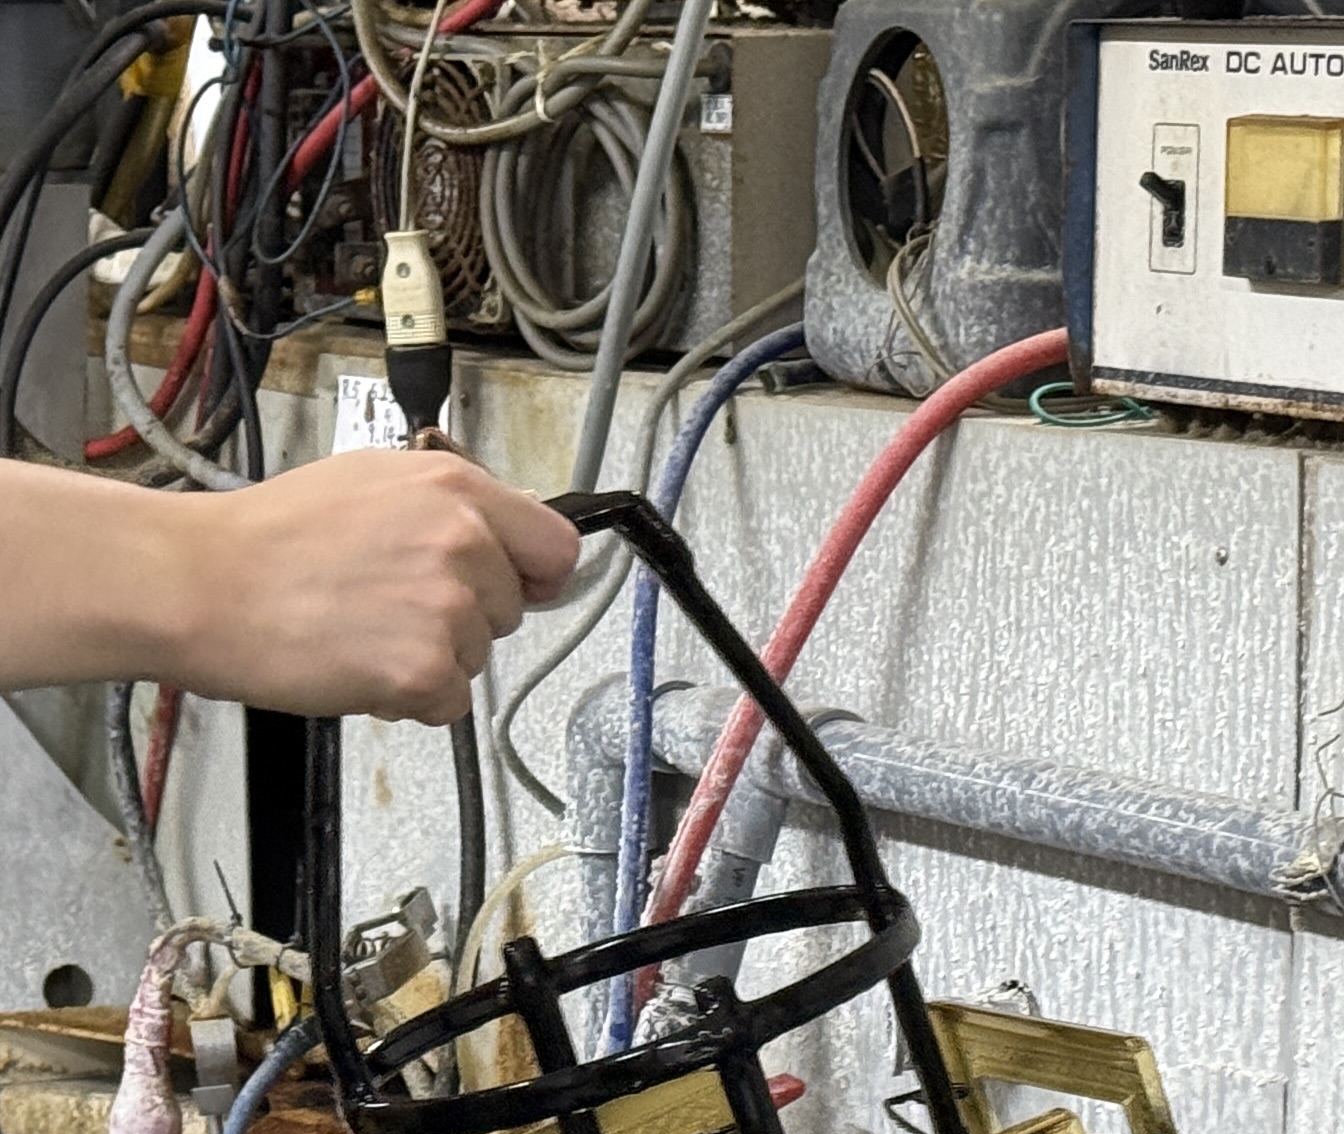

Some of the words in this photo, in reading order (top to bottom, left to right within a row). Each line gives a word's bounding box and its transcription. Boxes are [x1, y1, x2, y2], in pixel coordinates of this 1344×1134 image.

[1149, 49, 1209, 72] SanRex
[1226, 51, 1261, 73] DC
[1270, 53, 1344, 77] AUTO
